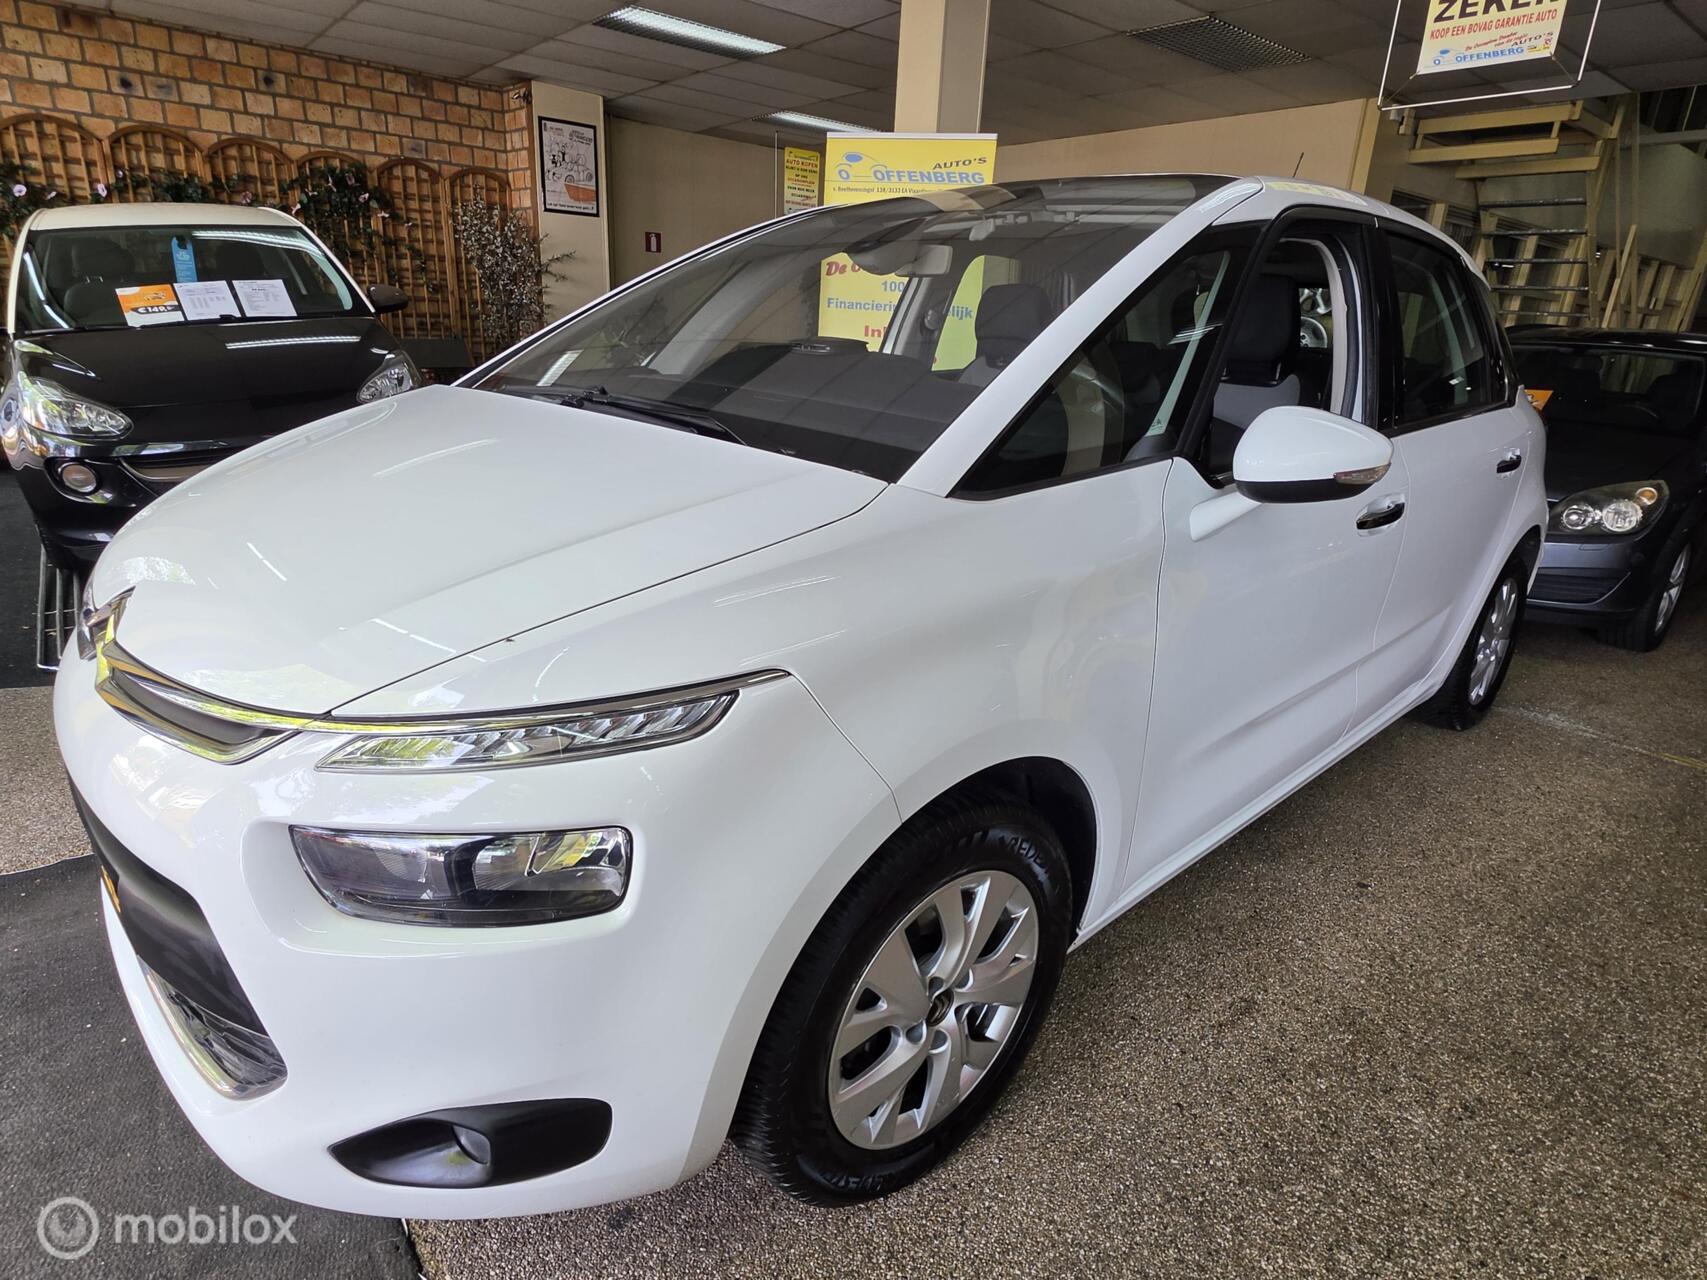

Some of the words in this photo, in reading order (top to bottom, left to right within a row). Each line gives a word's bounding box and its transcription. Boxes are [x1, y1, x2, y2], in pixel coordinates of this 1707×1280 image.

[1433, 0, 1559, 23] ZEK
[1430, 27, 1450, 40] KOOP
[1451, 25, 1466, 37] EEN
[1467, 21, 1493, 34] BOVAG
[1495, 14, 1534, 30] GARANTIE
[1535, 9, 1558, 22] AUTO
[1511, 31, 1554, 47] AUTO'S
[1455, 46, 1524, 63] OFFENBERG
[932, 156, 987, 170] AUTO'S
[873, 169, 985, 184] OFFENBERG
[825, 260, 847, 276] De
